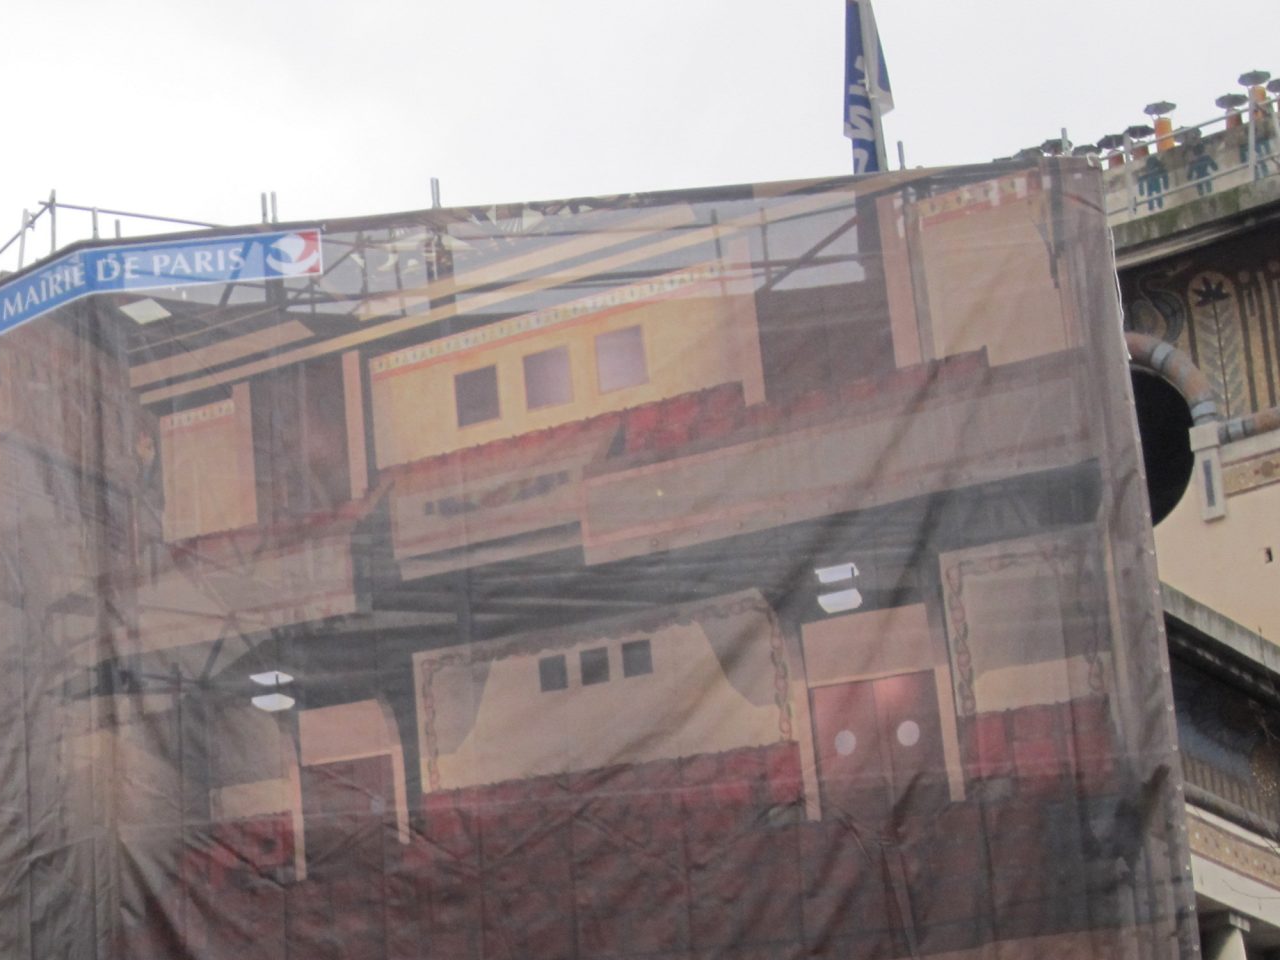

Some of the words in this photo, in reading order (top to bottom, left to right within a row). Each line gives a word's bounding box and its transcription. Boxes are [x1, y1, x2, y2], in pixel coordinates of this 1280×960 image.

[2, 260, 87, 321] MAIRIE
[95, 254, 142, 283] DE
[153, 246, 246, 278] PARIS
